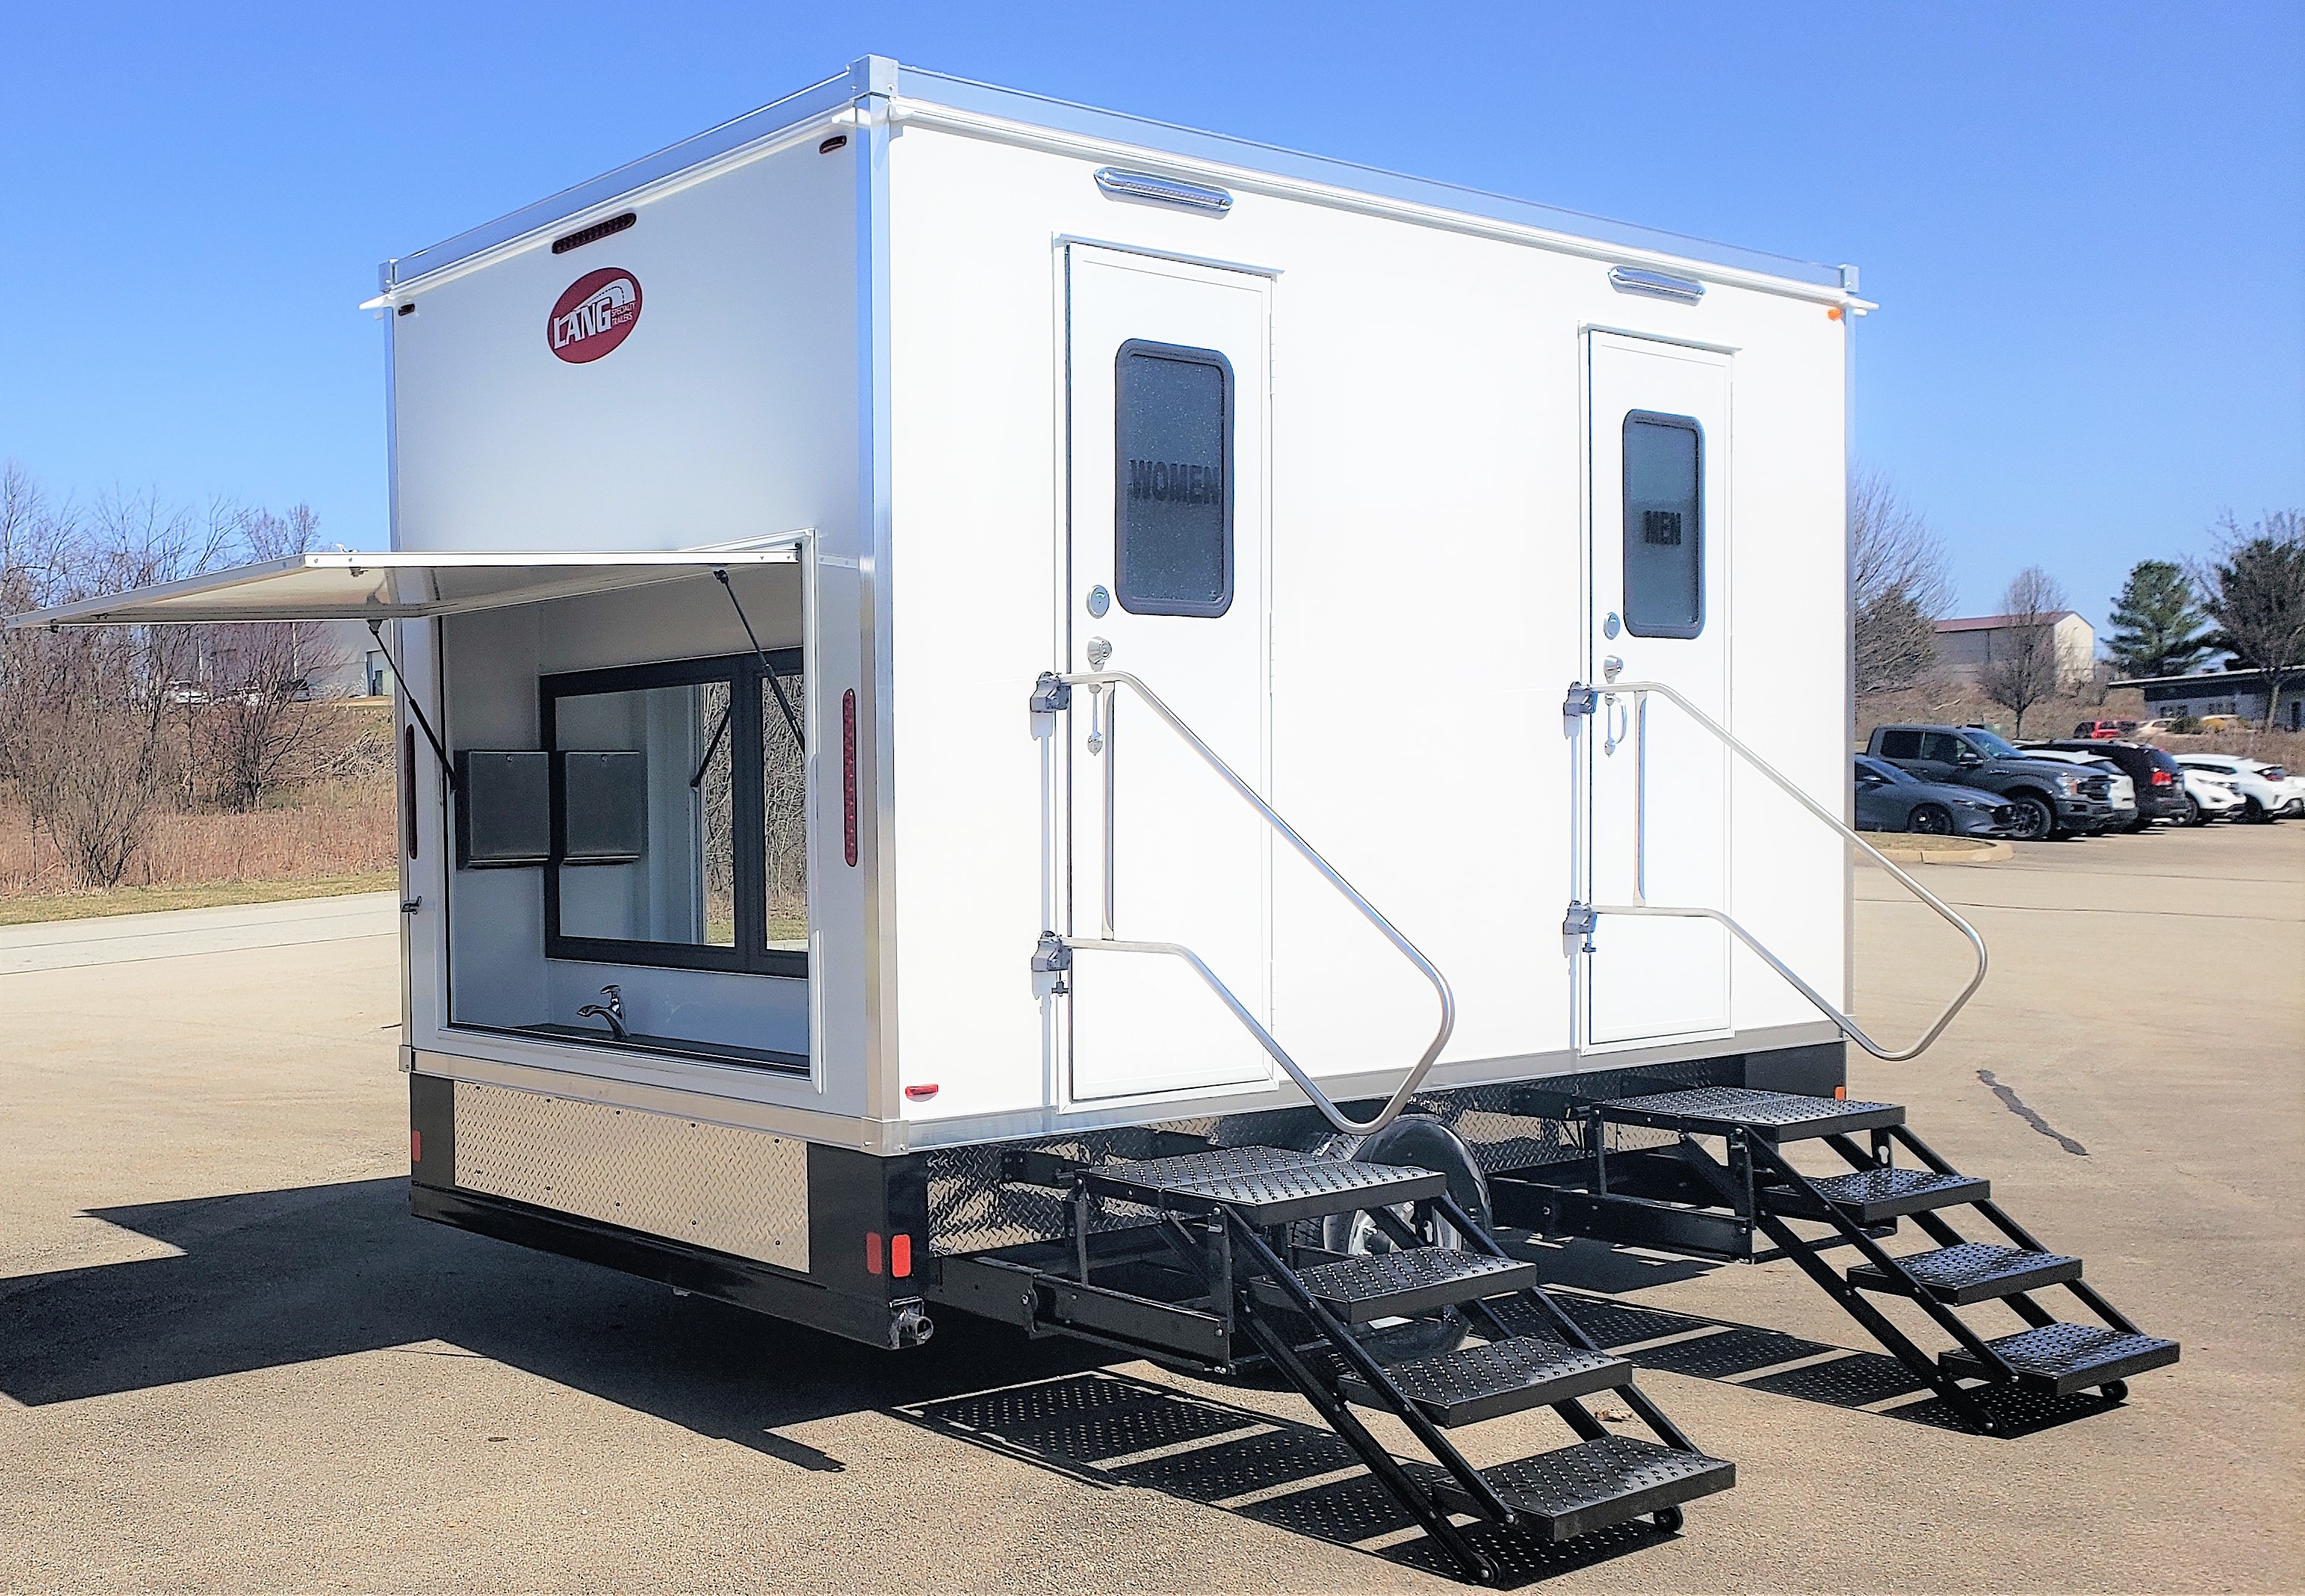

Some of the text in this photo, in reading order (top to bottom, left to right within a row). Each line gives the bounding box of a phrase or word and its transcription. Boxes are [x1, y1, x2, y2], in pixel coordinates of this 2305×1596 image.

[553, 297, 612, 349] LANG
[1129, 459, 1220, 505] WOMEN
[1644, 510, 1682, 545] MEN
